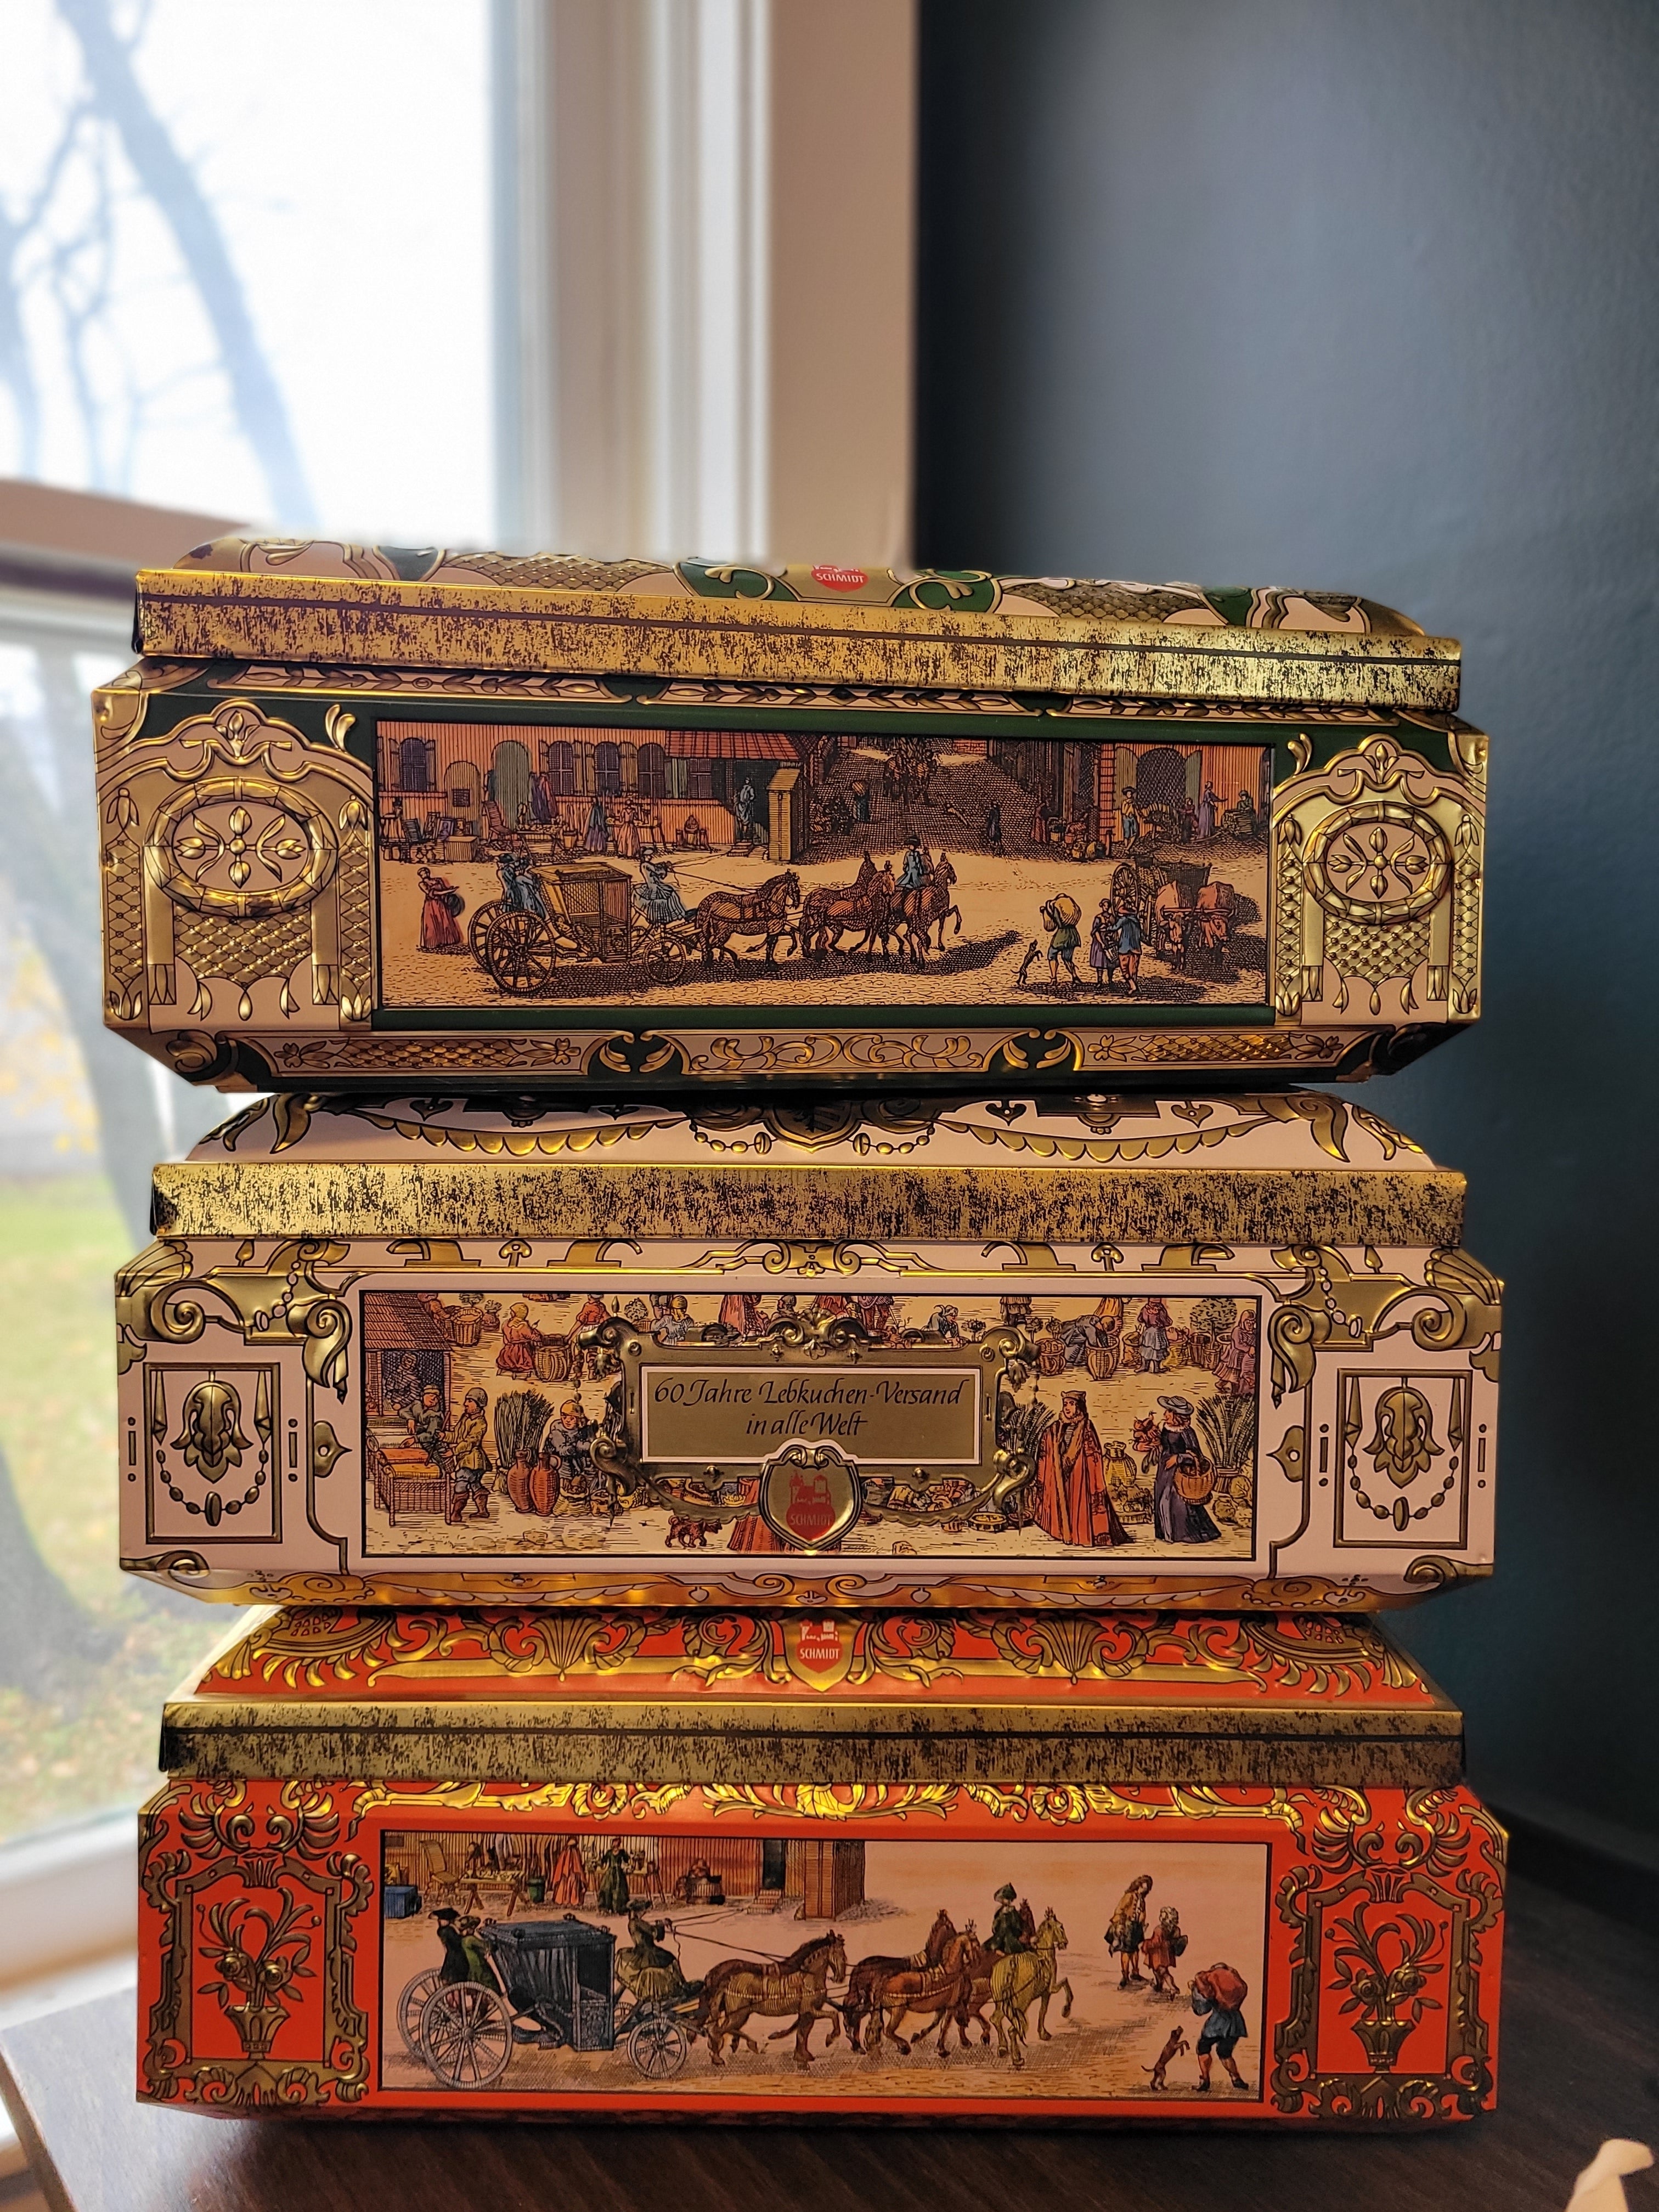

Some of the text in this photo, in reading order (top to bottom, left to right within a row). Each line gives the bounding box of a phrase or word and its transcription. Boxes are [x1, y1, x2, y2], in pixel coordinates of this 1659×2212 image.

[816, 573, 864, 583] SCHMIDT
[654, 1377, 970, 1407] 60 Jahre Lebkuchen-Versand
[746, 1409, 868, 1436] in alle Welt
[790, 1514, 832, 1526] SCHMIDT
[800, 1647, 840, 1660] SCHMIDT
